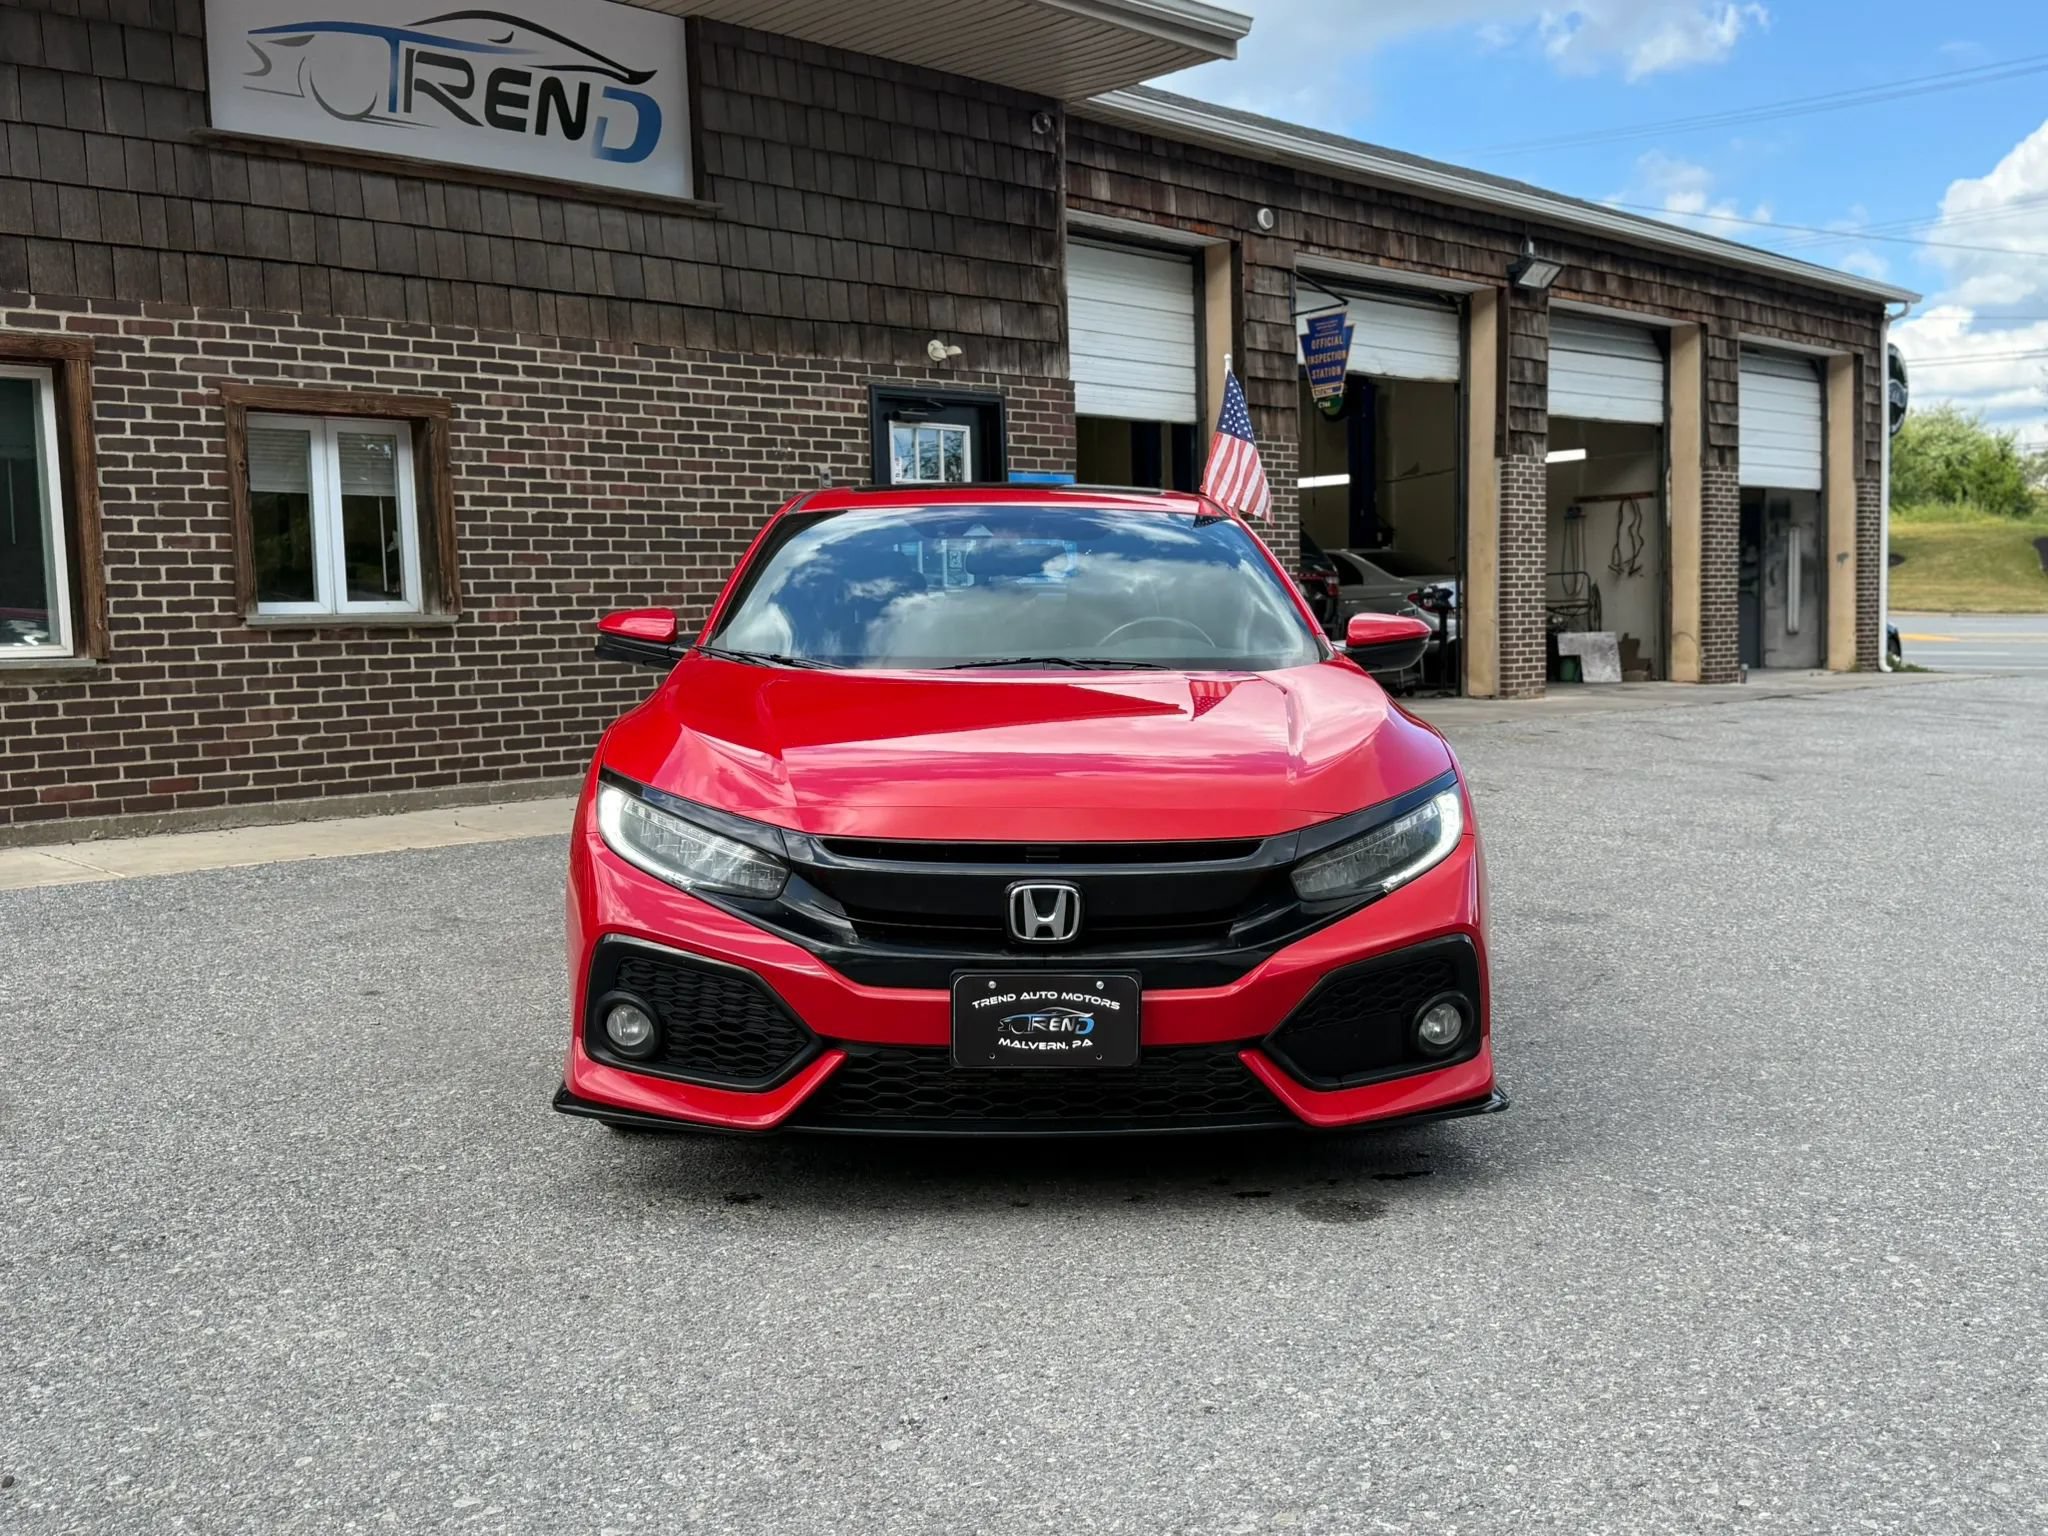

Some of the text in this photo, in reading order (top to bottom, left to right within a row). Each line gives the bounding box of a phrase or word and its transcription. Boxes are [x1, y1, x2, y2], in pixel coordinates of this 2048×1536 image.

[384, 30, 662, 164] TREND
[1311, 335, 1344, 350] OFFICIAL
[1307, 350, 1347, 364] INSPECTION
[1312, 366, 1342, 379] STATION
[971, 991, 1121, 1010] TREND AUTO MOTORS
[1026, 1014, 1095, 1035] TREND
[998, 1037, 1093, 1050] MALVERN, PA
